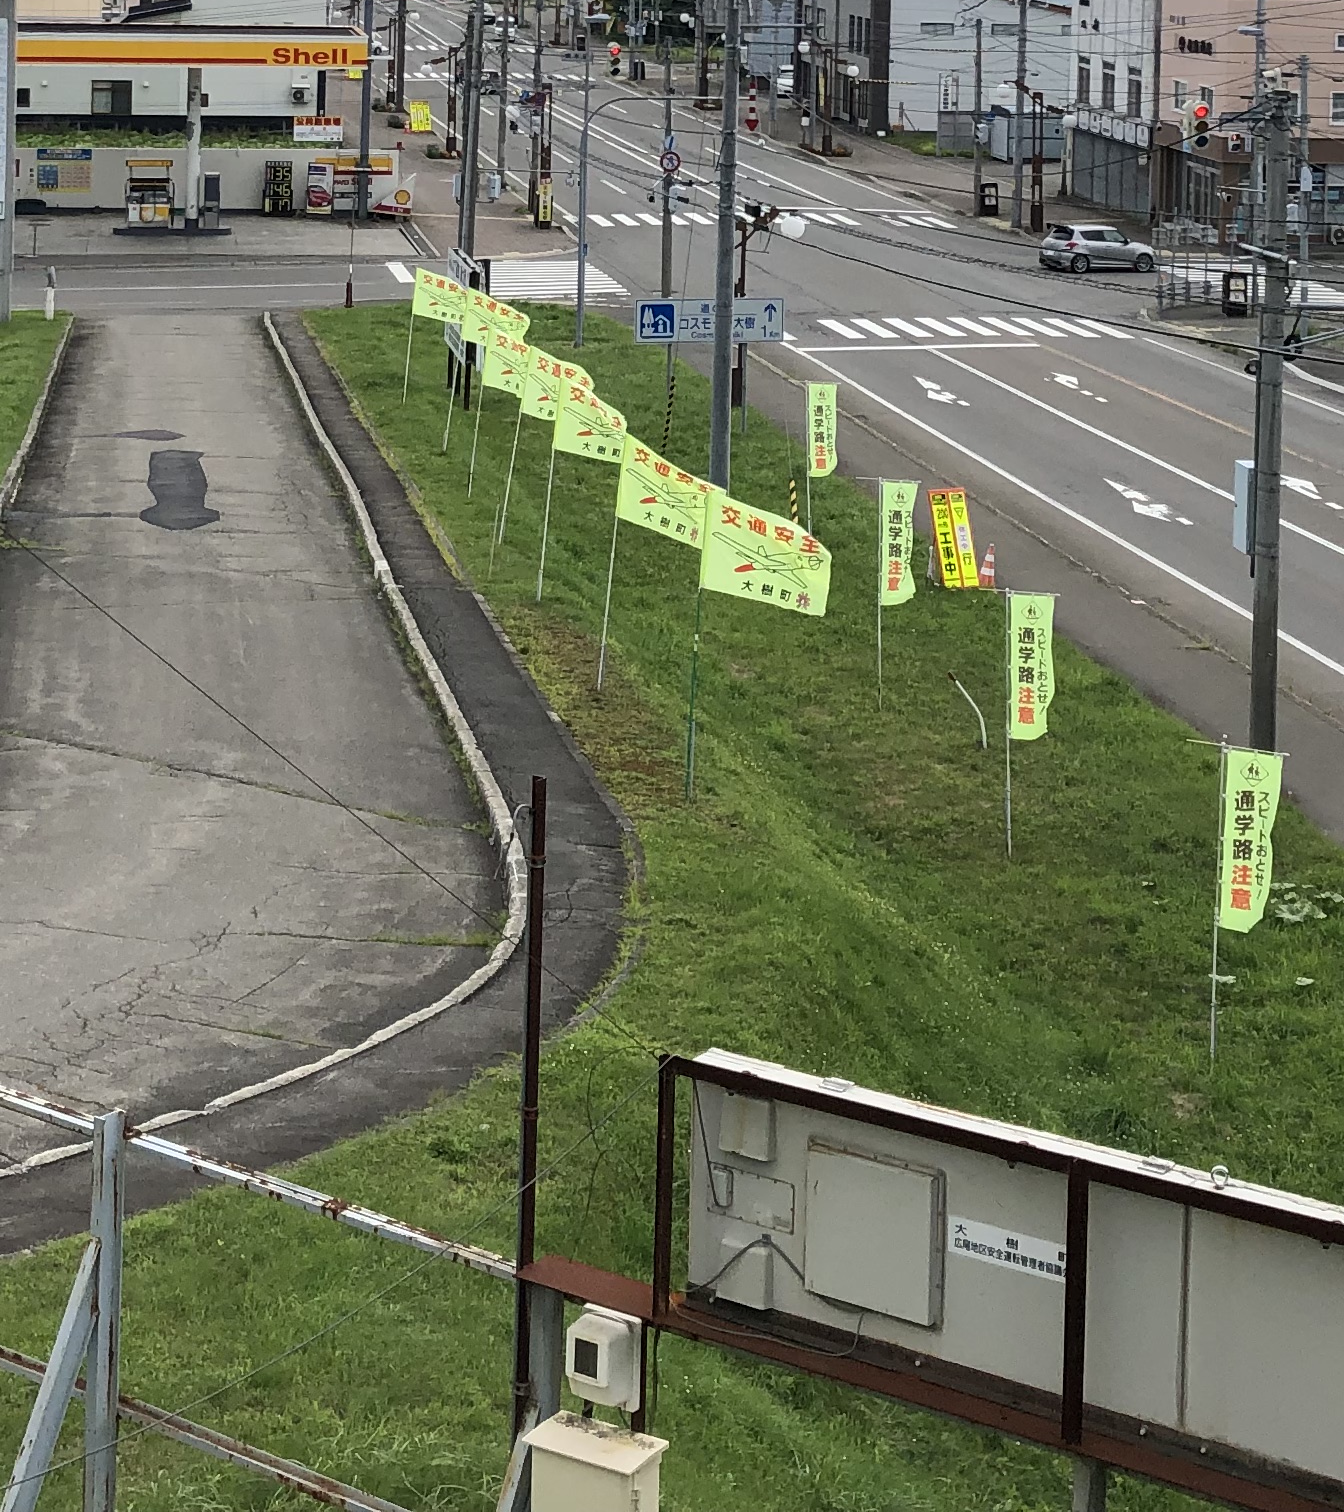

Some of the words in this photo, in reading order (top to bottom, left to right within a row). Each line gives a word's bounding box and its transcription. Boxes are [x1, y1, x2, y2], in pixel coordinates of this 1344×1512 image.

[272, 47, 348, 65] Shell
[270, 167, 291, 181] 135
[270, 183, 291, 196] 146
[721, 505, 821, 556] 交通安全
[887, 509, 904, 592] 通学路注意
[939, 532, 957, 576] 工事中
[740, 579, 792, 603] 大樹町
[1017, 626, 1036, 726] 通学路注意
[1230, 790, 1255, 911] 通学路注意
